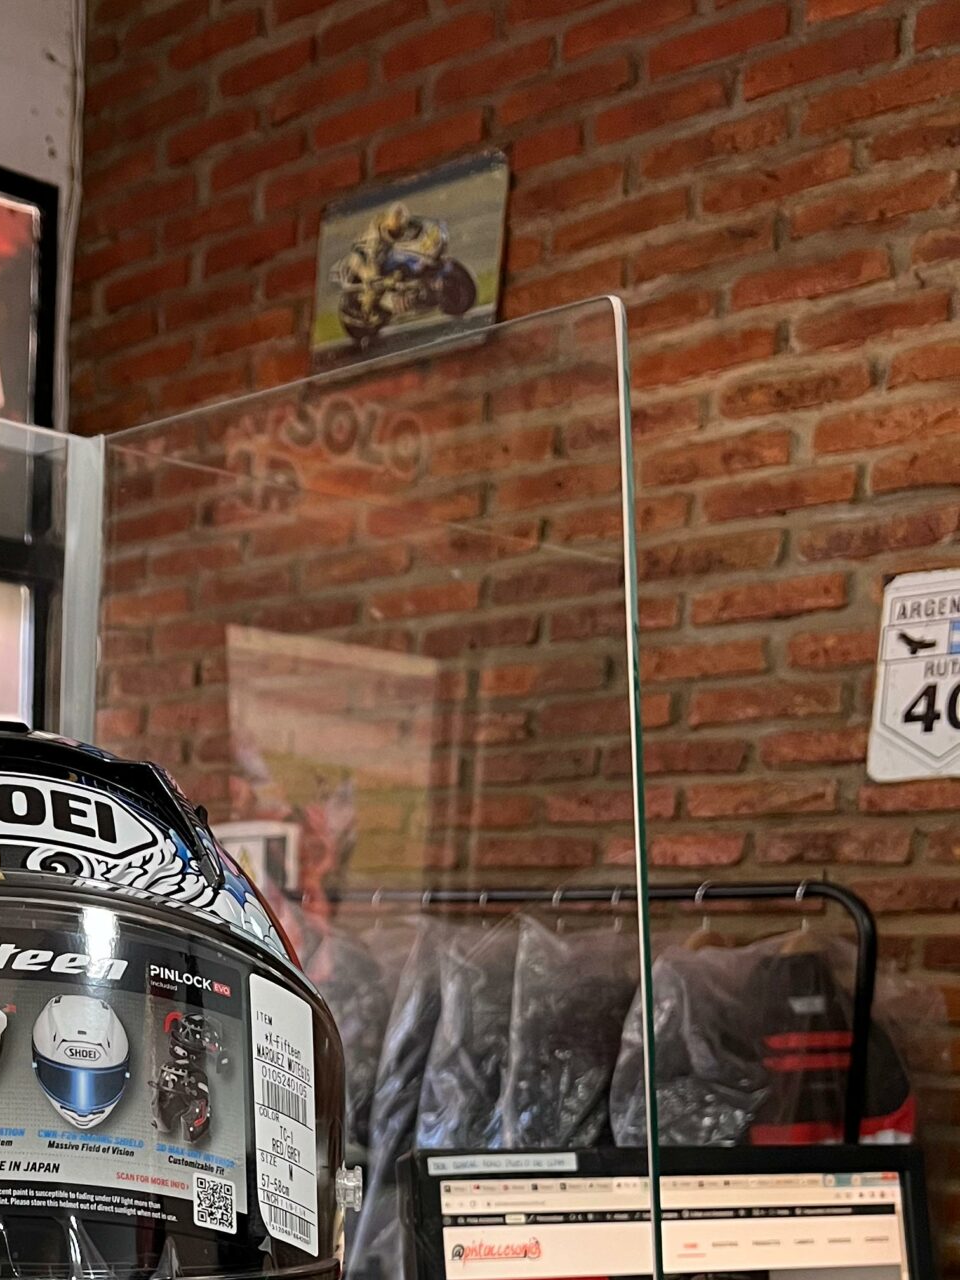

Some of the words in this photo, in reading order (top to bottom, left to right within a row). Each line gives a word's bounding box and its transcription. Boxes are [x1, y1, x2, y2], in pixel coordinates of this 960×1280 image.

[149, 964, 212, 992] PINLOCK
[213, 981, 231, 997] EVO
[256, 1010, 273, 1026] ITEM
[68, 1047, 97, 1059] SHOEI
[256, 1043, 285, 1069] MARQUEZ
[259, 1106, 280, 1122] COLOR
[279, 1125, 294, 1144] TC-1
[47, 1139, 80, 1151] Massive
[81, 1143, 101, 1153] Field
[102, 1145, 111, 1154] of
[111, 1146, 135, 1157] Vision
[8, 1161, 21, 1172] IN
[23, 1161, 60, 1174] JAPAN
[168, 1155, 215, 1174] Customizable
[215, 1166, 226, 1176] Fit
[260, 1152, 278, 1167] SIZE
[116, 1172, 137, 1182] SCAN
[137, 1174, 150, 1184] FOR
[150, 1176, 170, 1187] MORE
[170, 1179, 186, 1190] INFO
[10, 1197, 30, 1206] Please
[30, 1198, 47, 1207] store
[47, 1199, 59, 1208] this
[59, 1199, 79, 1209] helmet
[79, 1202, 90, 1210] out
[97, 1203, 114, 1213] direct
[12, 1187, 28, 1198] paint
[35, 1189, 68, 1199] susceptible
[76, 1191, 95, 1202] fading
[95, 1194, 112, 1203] under
[112, 1195, 121, 1203] UV
[121, 1196, 134, 1206] light
